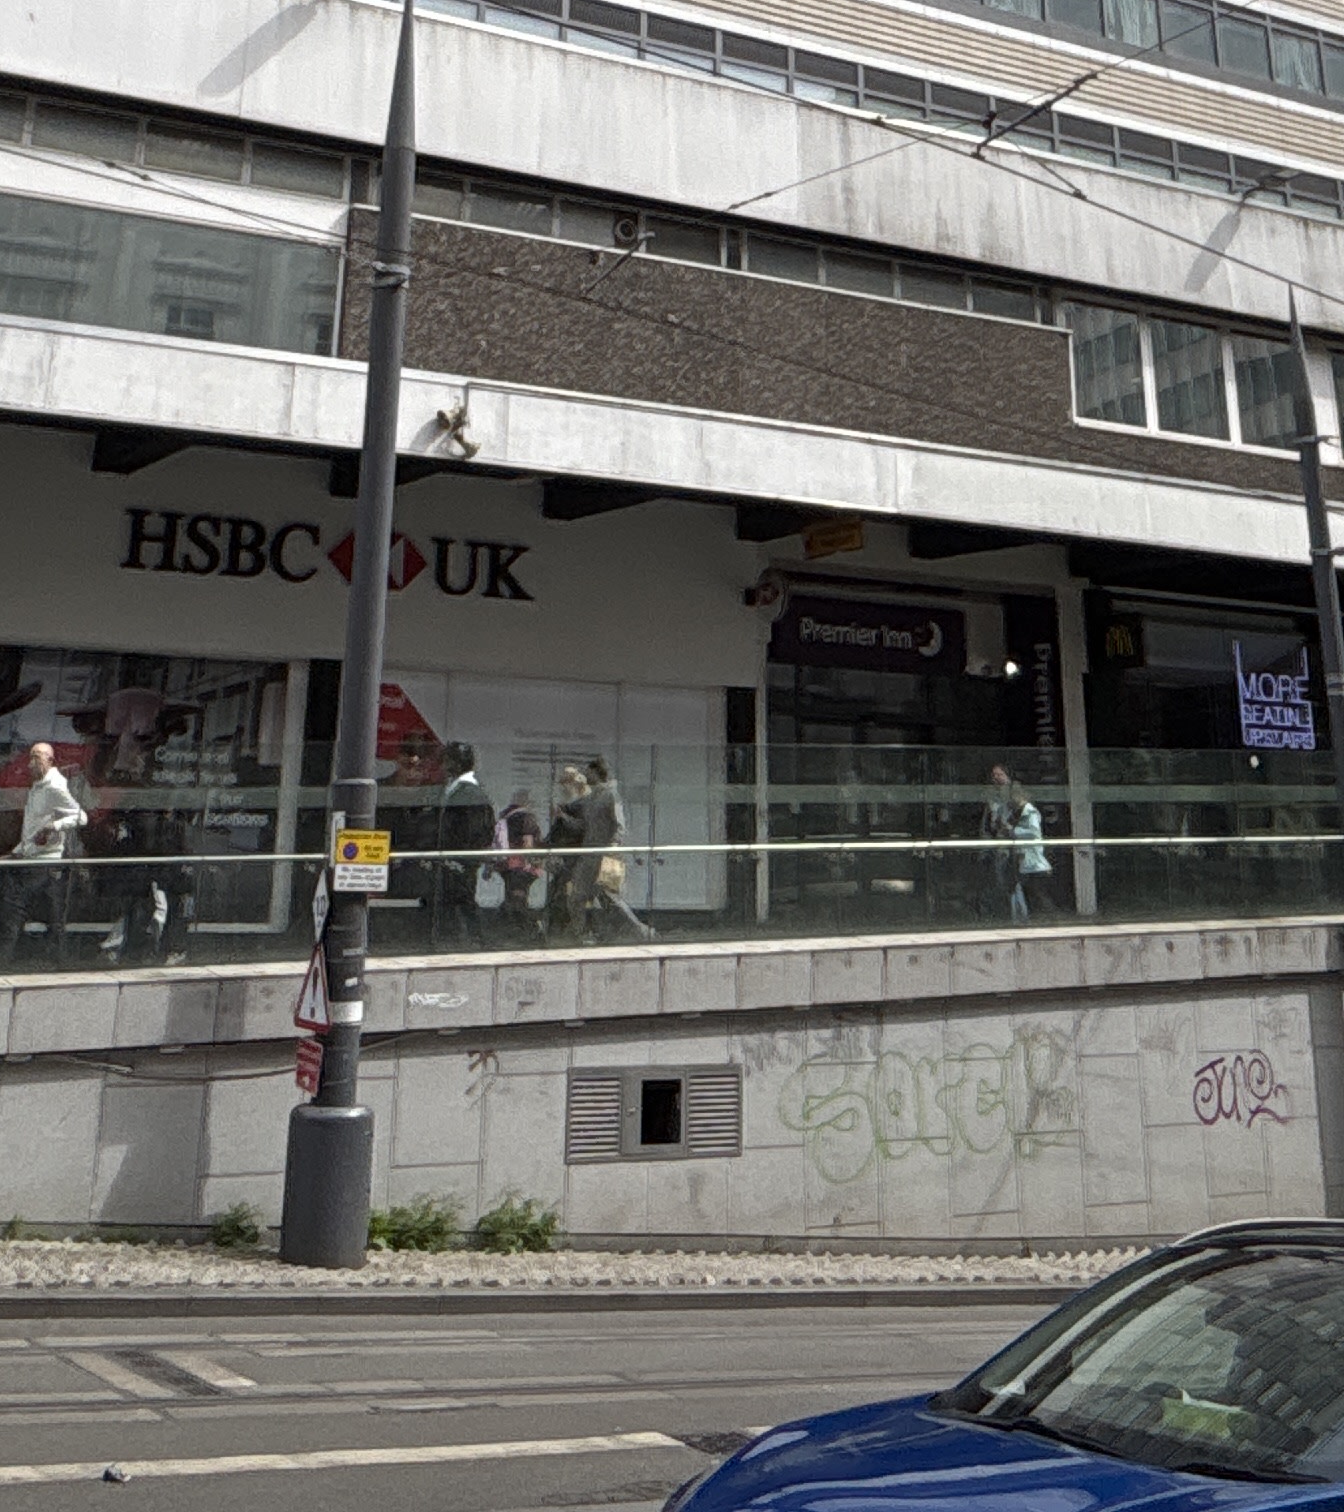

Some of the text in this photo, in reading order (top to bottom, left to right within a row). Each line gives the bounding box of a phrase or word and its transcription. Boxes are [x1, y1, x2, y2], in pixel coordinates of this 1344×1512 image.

[119, 507, 535, 602] HSBC UK
[798, 615, 913, 650] Premier Inn
[1237, 672, 1310, 703] MORE
